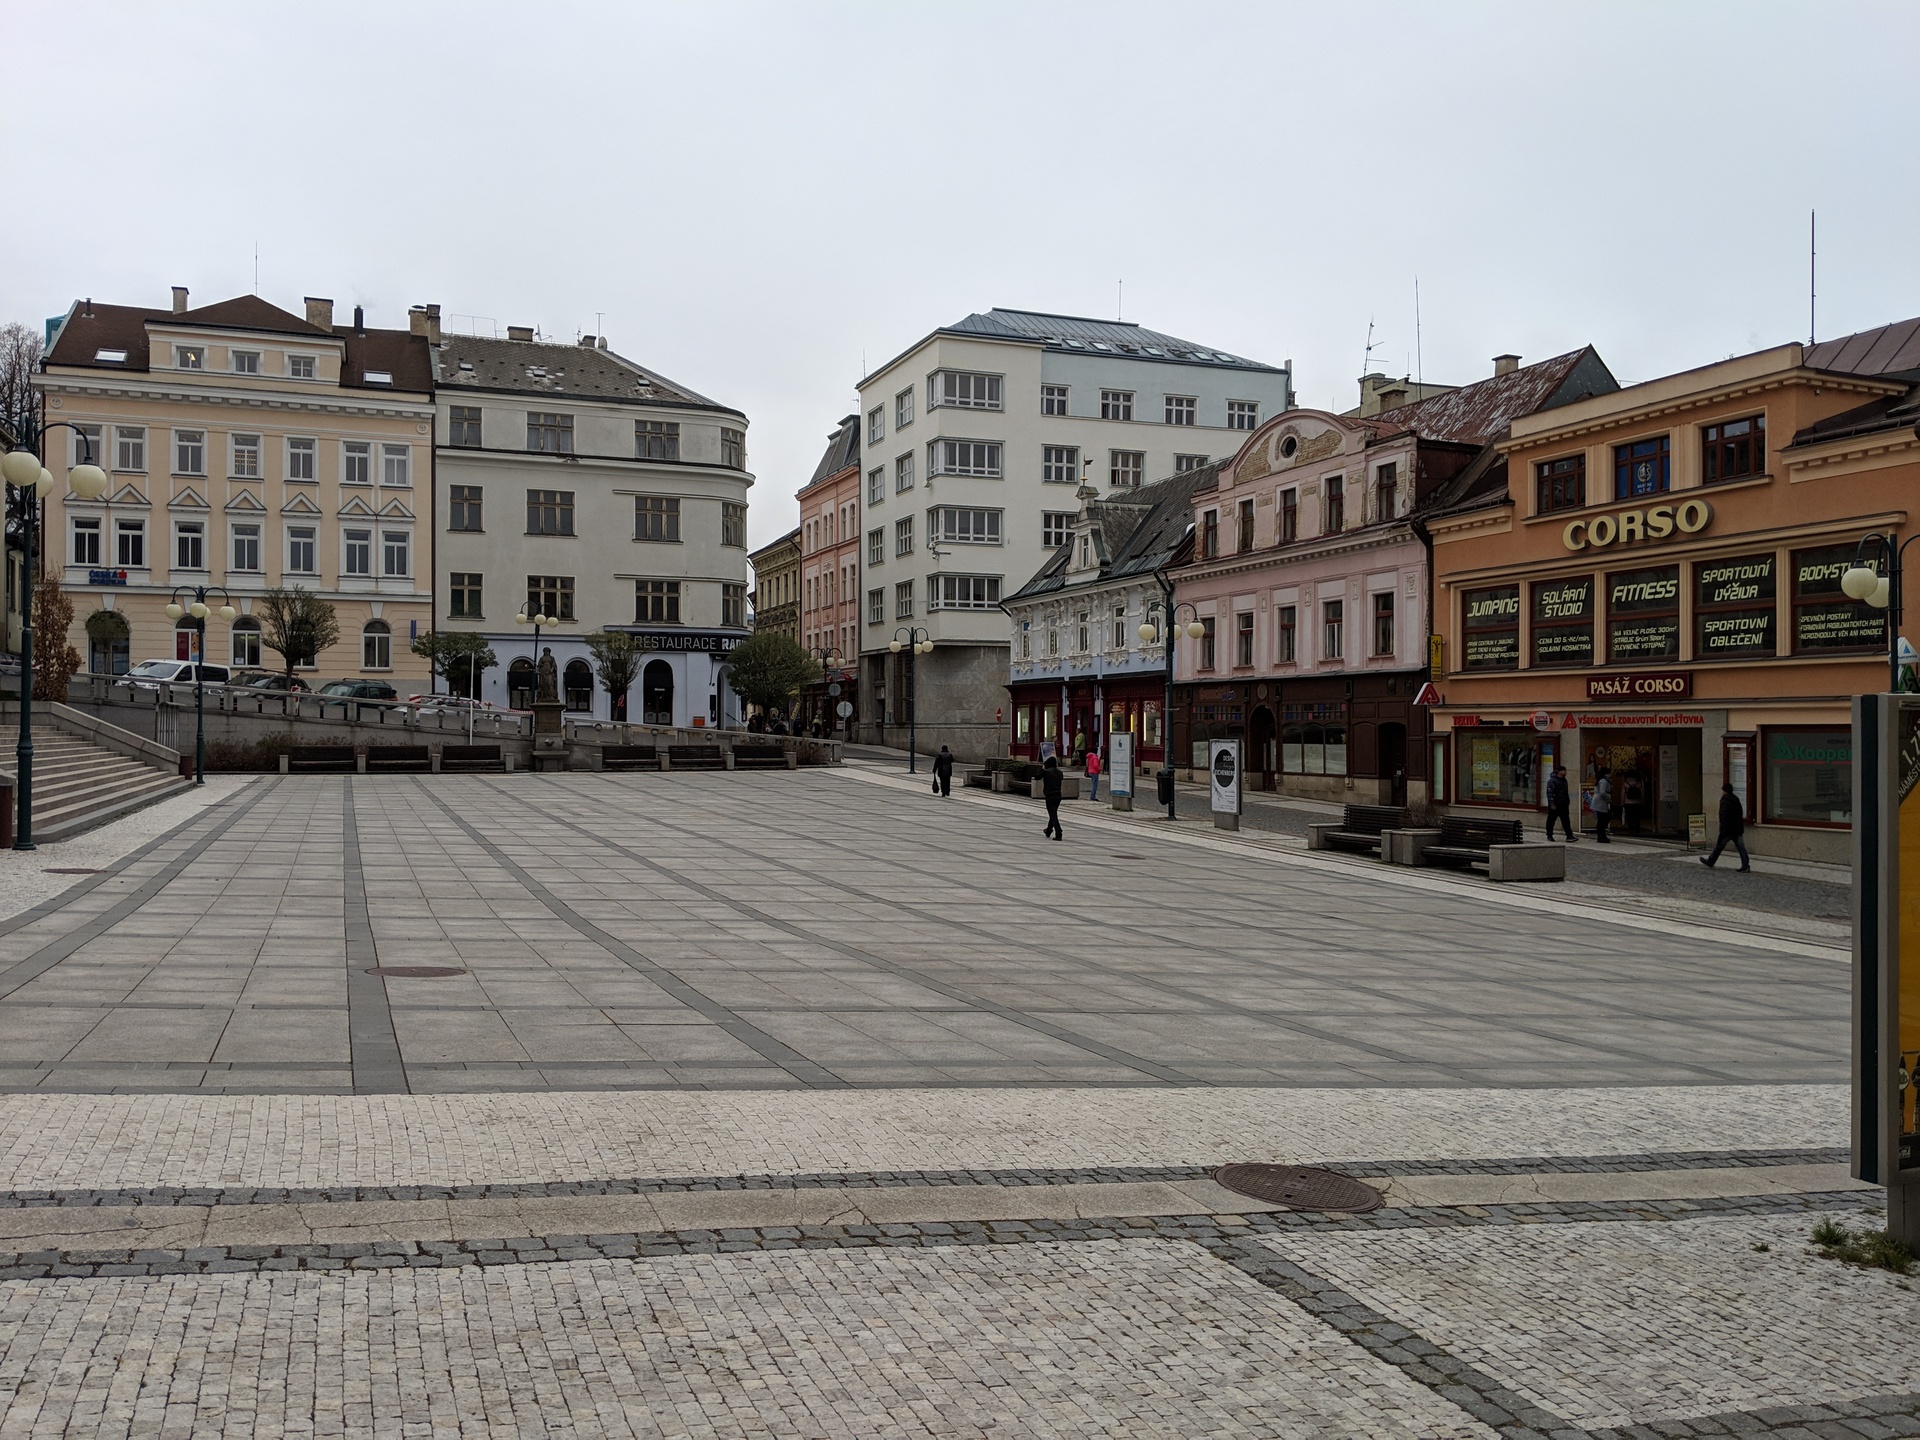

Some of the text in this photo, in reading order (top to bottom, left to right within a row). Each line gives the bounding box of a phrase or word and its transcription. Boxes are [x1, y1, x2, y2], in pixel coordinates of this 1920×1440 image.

[1562, 499, 1711, 551] CORSO
[1541, 582, 1589, 604] SOLÁRNÍ
[1612, 579, 1678, 603] FITNESS
[1467, 597, 1519, 617] JUMPING
[1544, 602, 1583, 617] STUDIO
[1705, 616, 1768, 632] SPORTOVNÍ
[634, 635, 717, 650] RESTAURACE
[1709, 632, 1763, 647] OBLEČENÍ
[1590, 676, 1685, 695] PASÁŽ CORSO
[1578, 713, 1705, 725] VŠEOBECNÁ ZDRAVOTNÍ POJIŠŤOVNA
